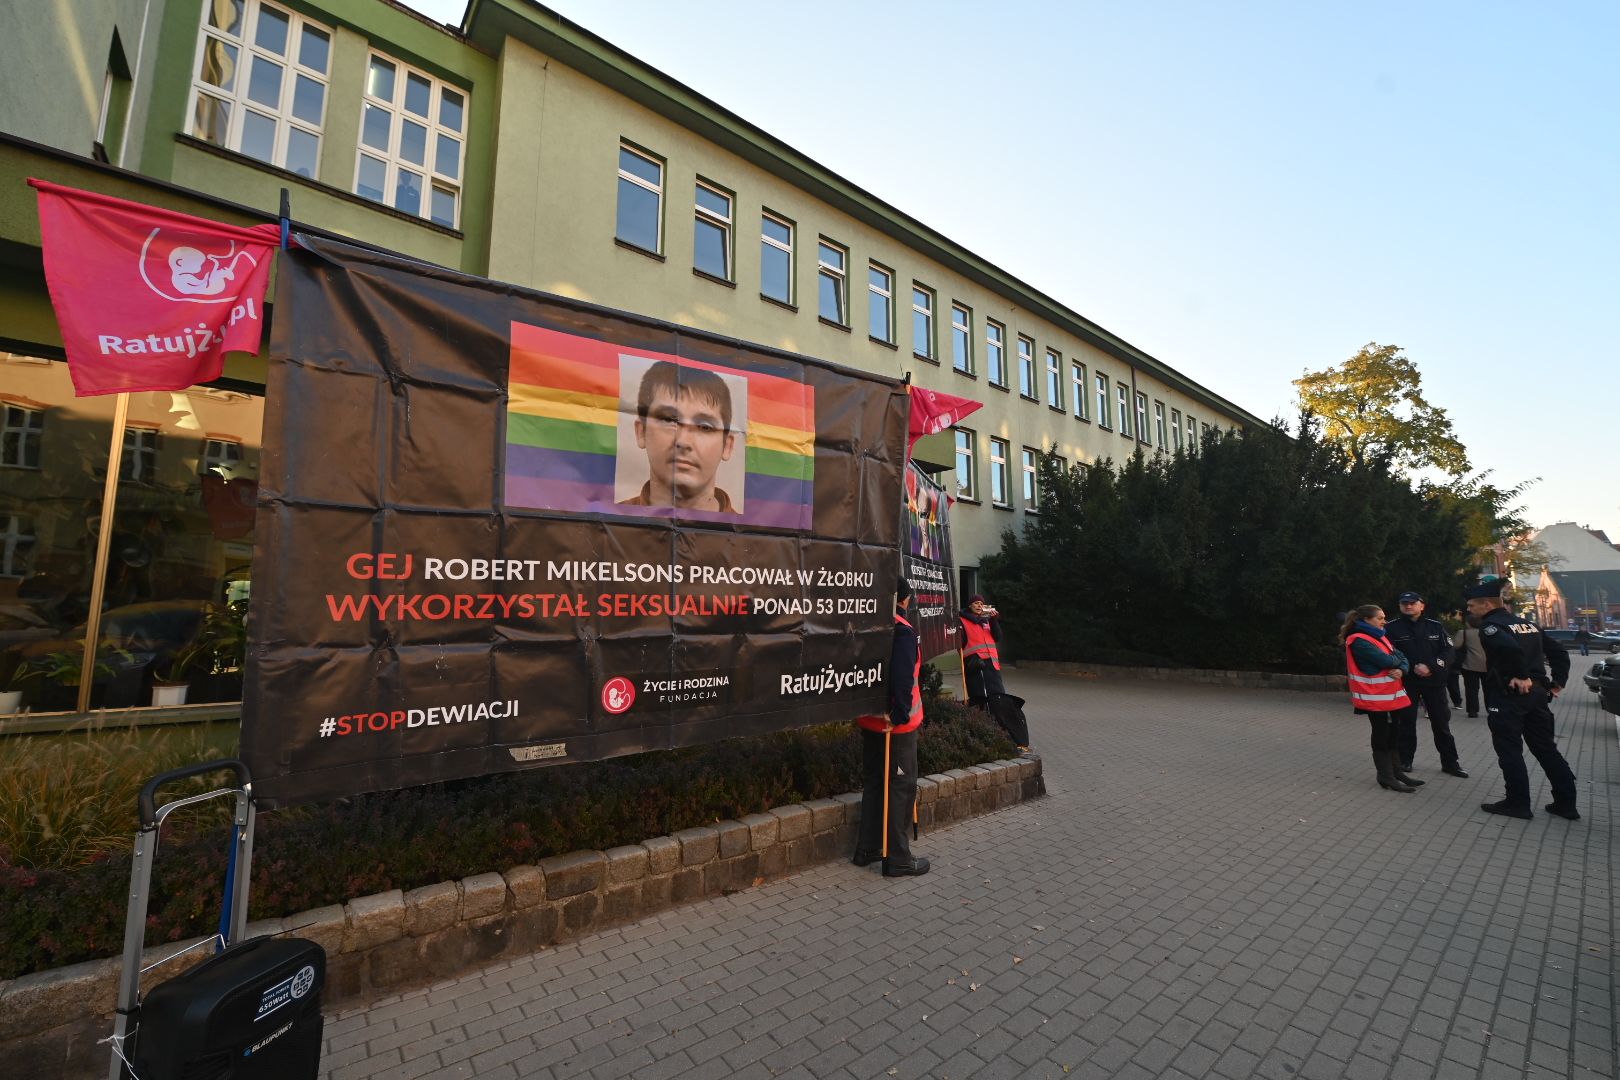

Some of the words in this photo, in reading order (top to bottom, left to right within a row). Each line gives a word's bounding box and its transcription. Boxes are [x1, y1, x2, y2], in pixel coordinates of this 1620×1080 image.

[347, 553, 413, 580] GEJ
[424, 558, 540, 581] ROBERT
[547, 560, 684, 583] MIKELSONS
[690, 565, 793, 586] PRACOWAŁ
[798, 570, 813, 586] W
[817, 566, 874, 588] ŻŁOBKU
[325, 593, 591, 622] WYKORZYSTAŁ
[597, 593, 750, 617] SEKSUALNIE
[753, 598, 813, 615] PONAD
[816, 599, 834, 615] 53
[837, 598, 877, 614] DZIECI
[643, 679, 677, 692] ŻYCIE
[678, 680, 682, 690] i
[684, 675, 730, 690] RODZINA
[780, 662, 882, 696] RatujŻycie.pl
[659, 690, 718, 703] FUNDACJA
[319, 699, 519, 738] #STOPDEWIACJI
[258, 991, 290, 1013] 650Watt
[262, 993, 276, 1003] TOTAL
[251, 1021, 294, 1053] BLAUPUNKT
